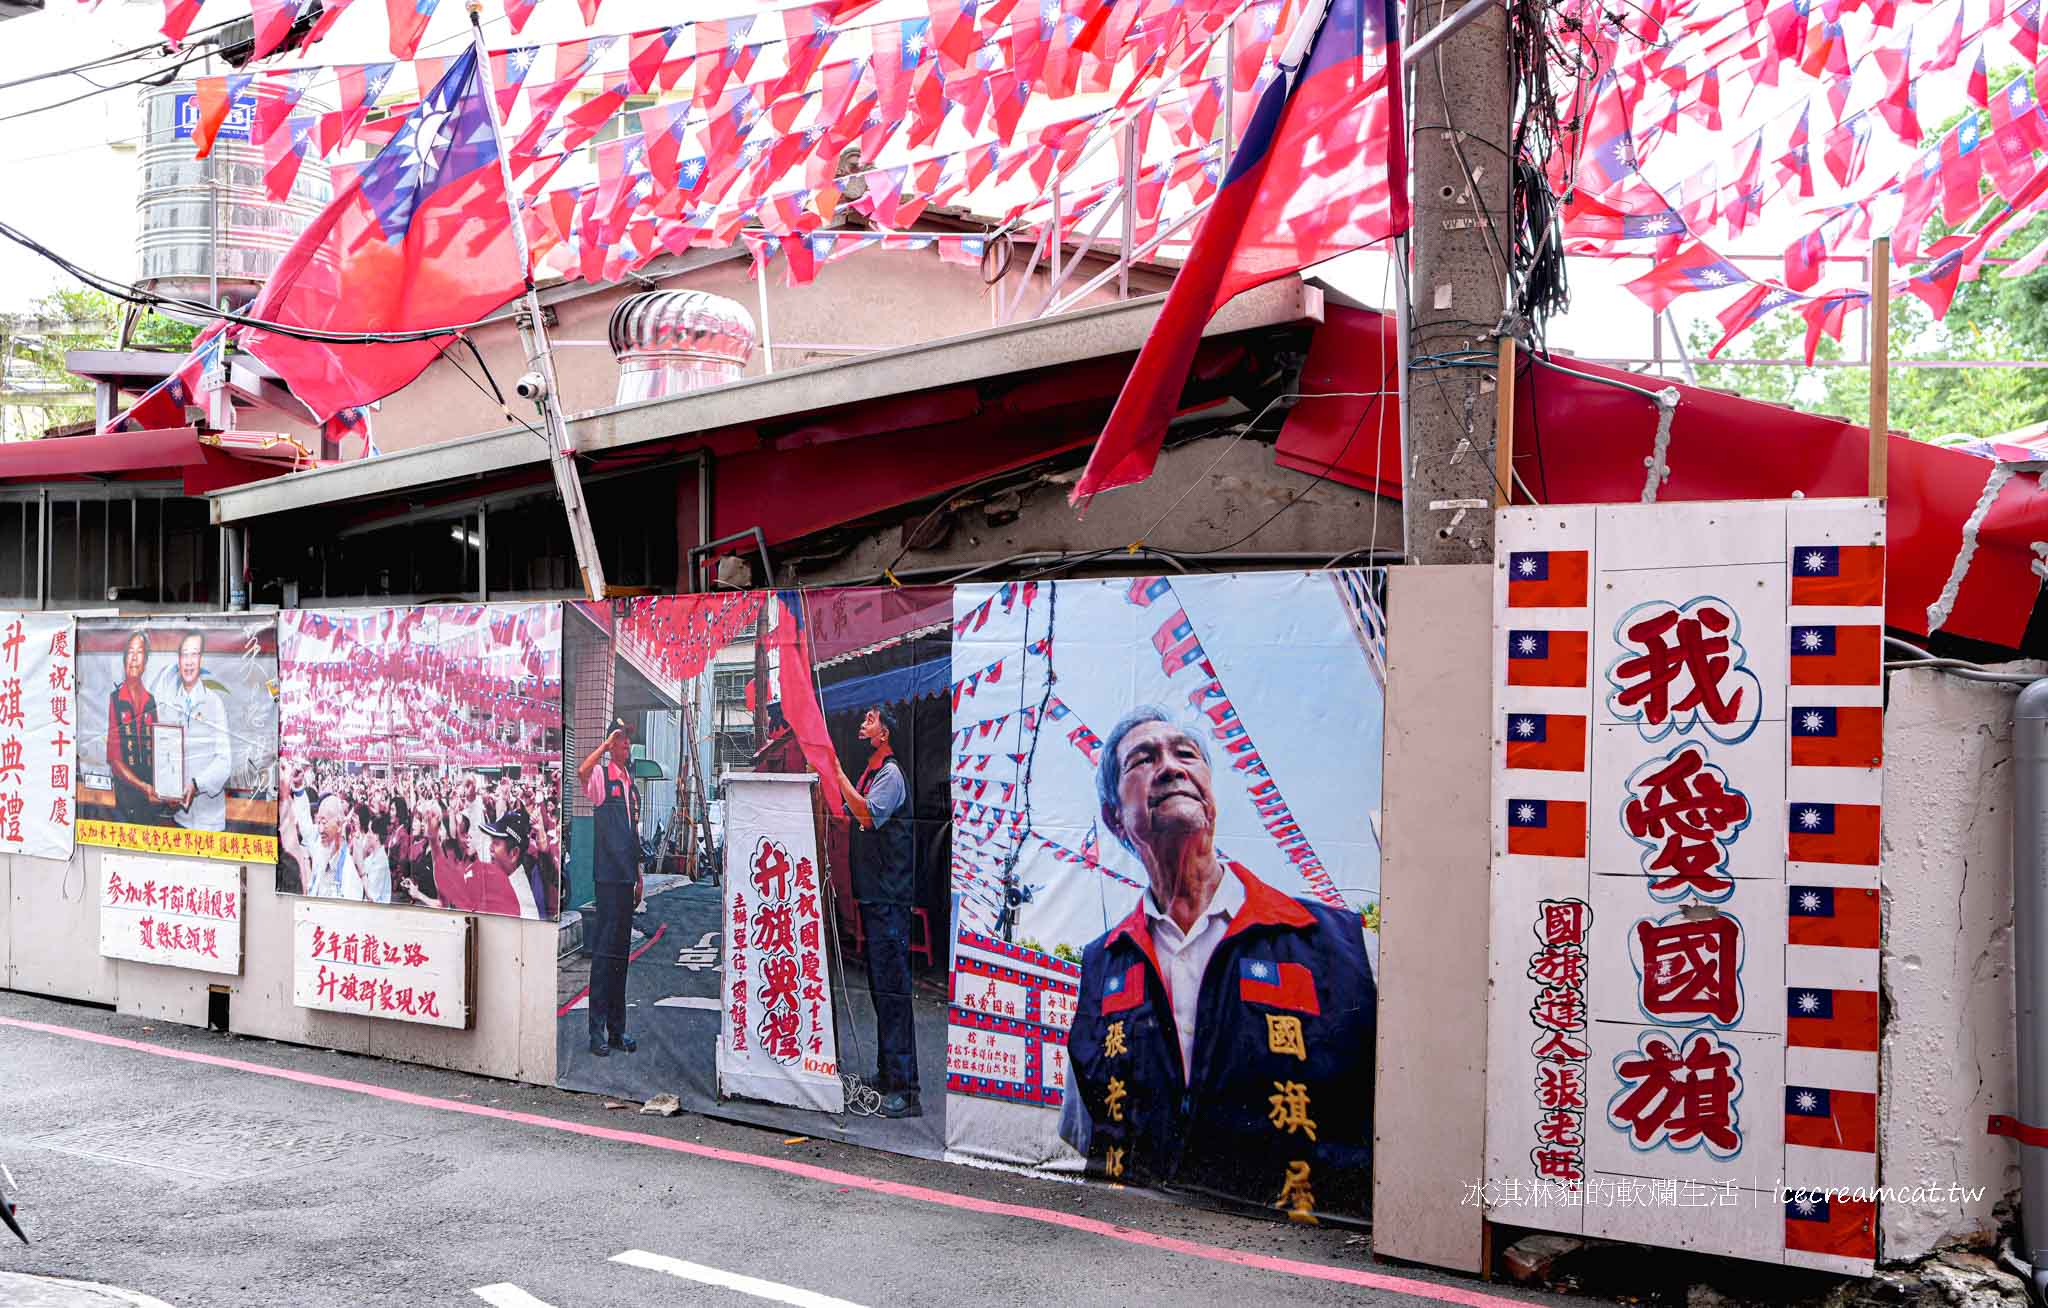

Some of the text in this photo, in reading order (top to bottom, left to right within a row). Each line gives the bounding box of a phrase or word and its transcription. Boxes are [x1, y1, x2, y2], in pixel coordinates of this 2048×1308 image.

[0, 620, 26, 843] 升旗典禮
[49, 630, 71, 826] 慶祝雙十國慶
[312, 925, 429, 967] 多年前龍江路
[754, 841, 800, 1059] 升旗典禮
[1614, 607, 1748, 1149] 我愛國旗
[804, 1057, 836, 1075] 10:00
[1265, 1013, 1318, 1224] 國旗屋
[1534, 902, 1589, 1191] 國旗達人張老旺
